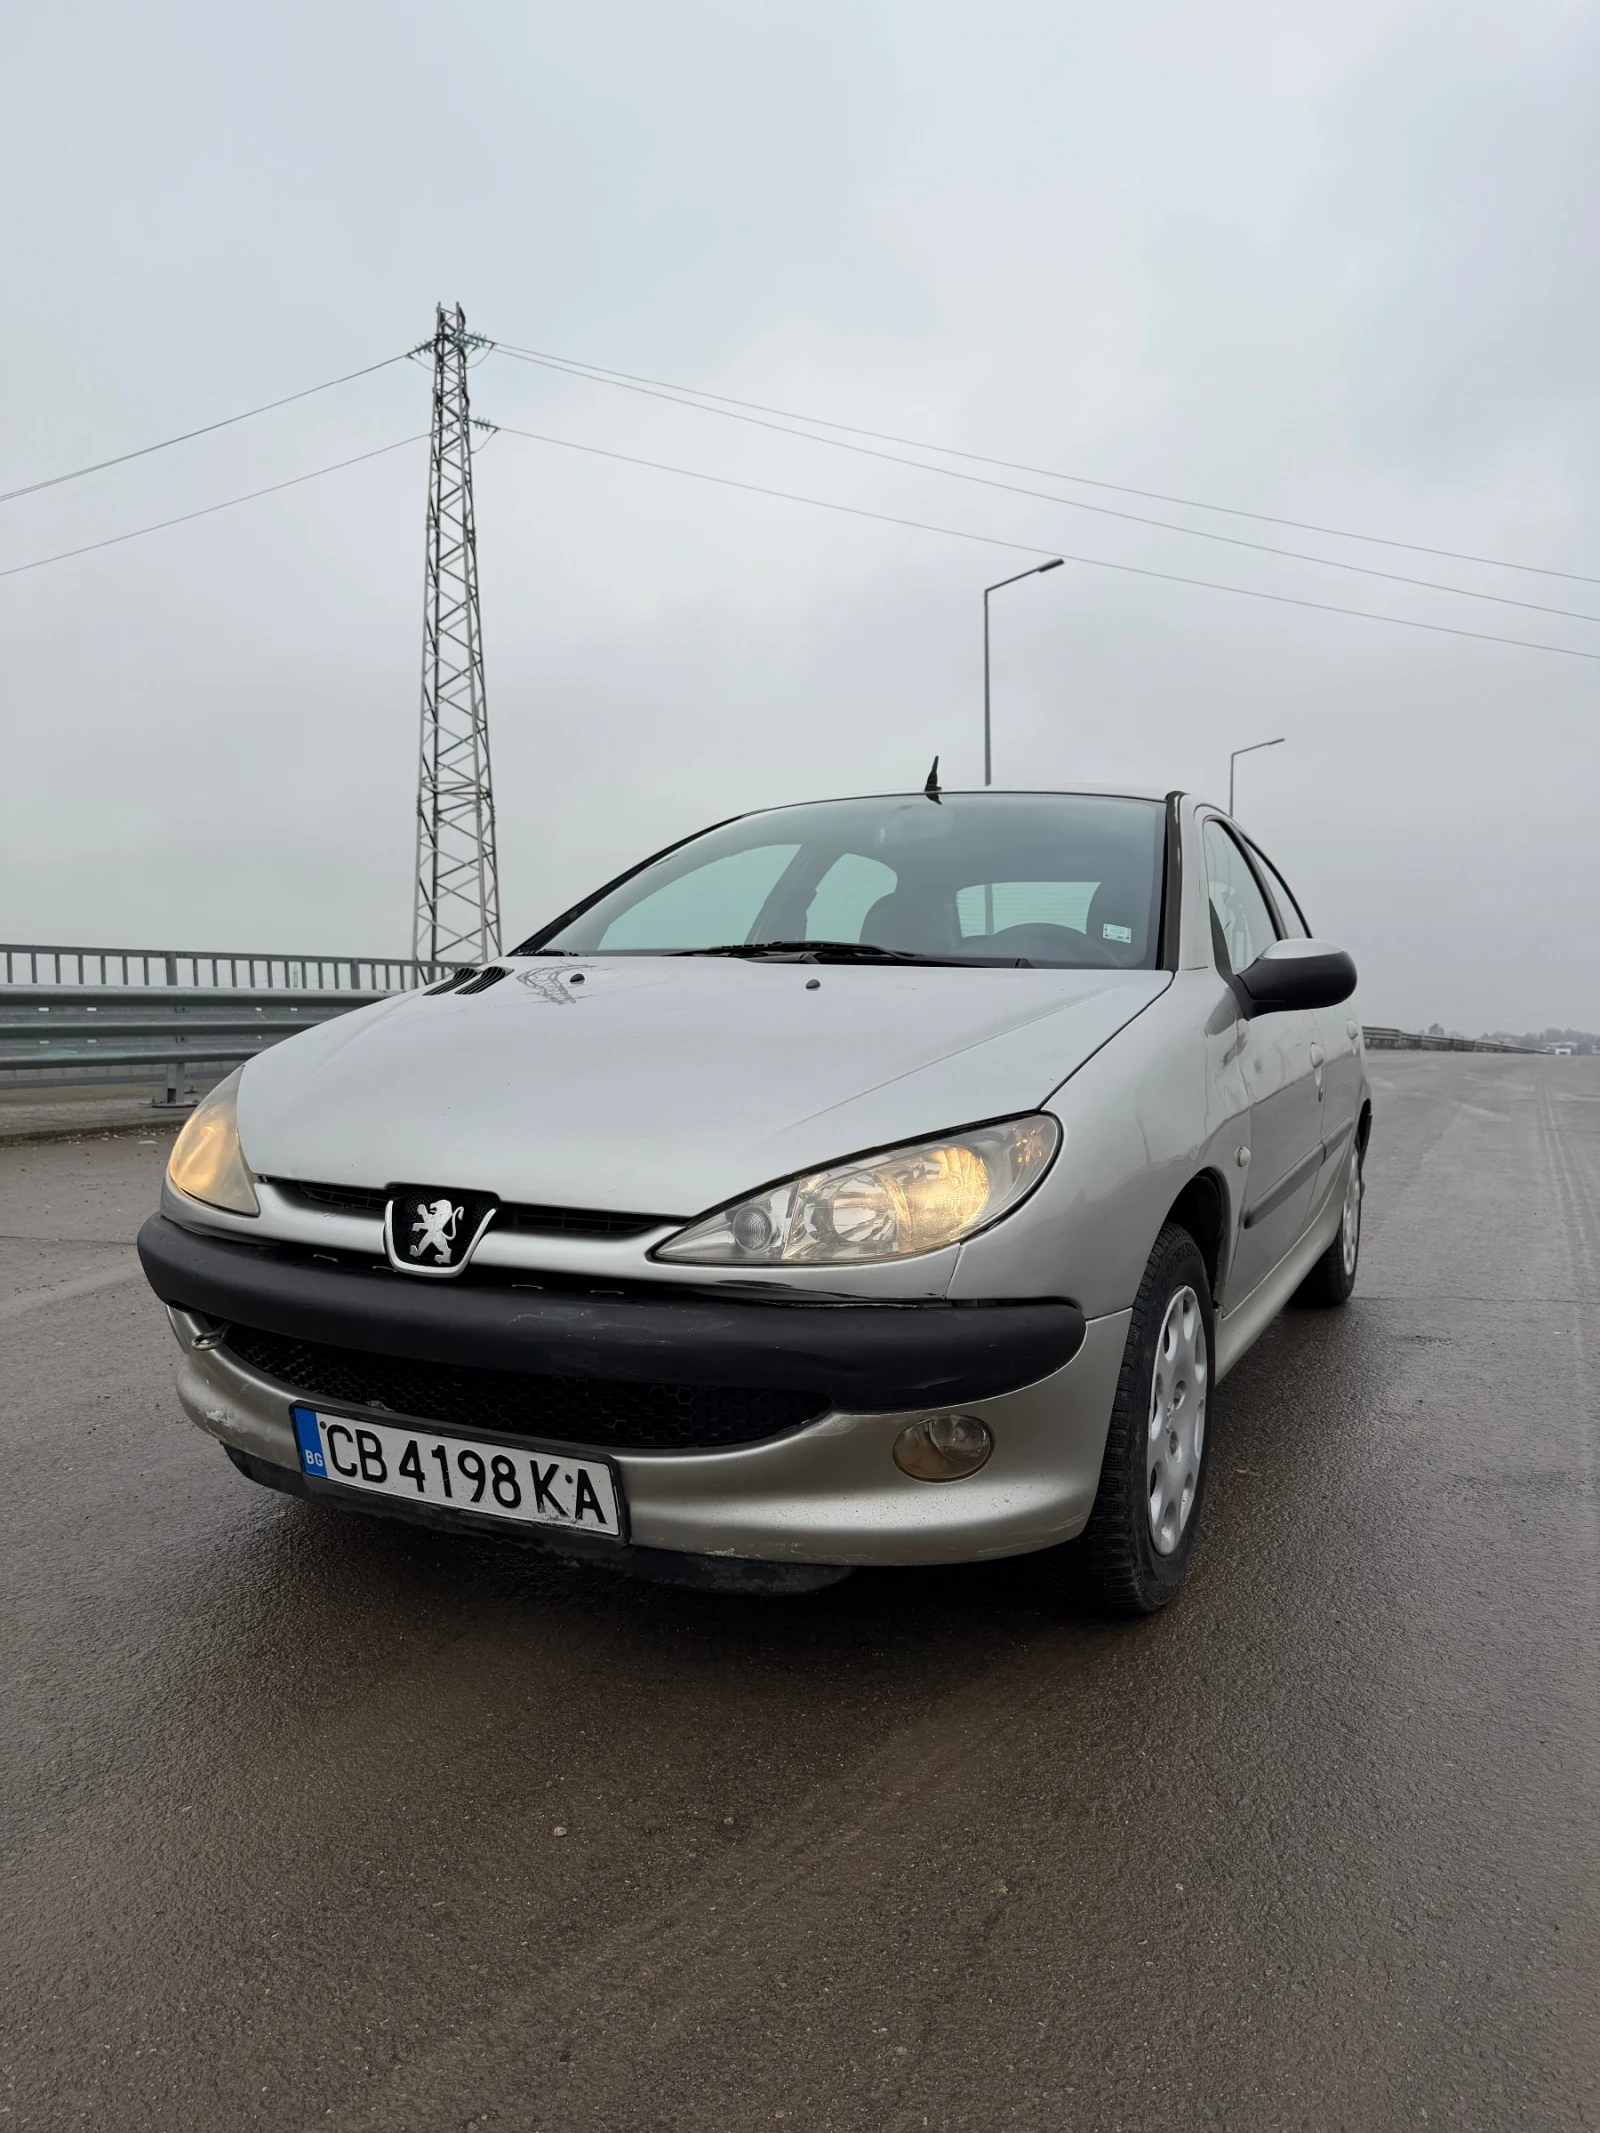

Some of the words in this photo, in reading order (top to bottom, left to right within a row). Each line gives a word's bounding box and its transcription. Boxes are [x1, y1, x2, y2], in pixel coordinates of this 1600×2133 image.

[305, 1450, 324, 1468] BG
[326, 1424, 388, 1484] CB
[399, 1440, 522, 1509] 4198
[530, 1460, 607, 1524] KA
